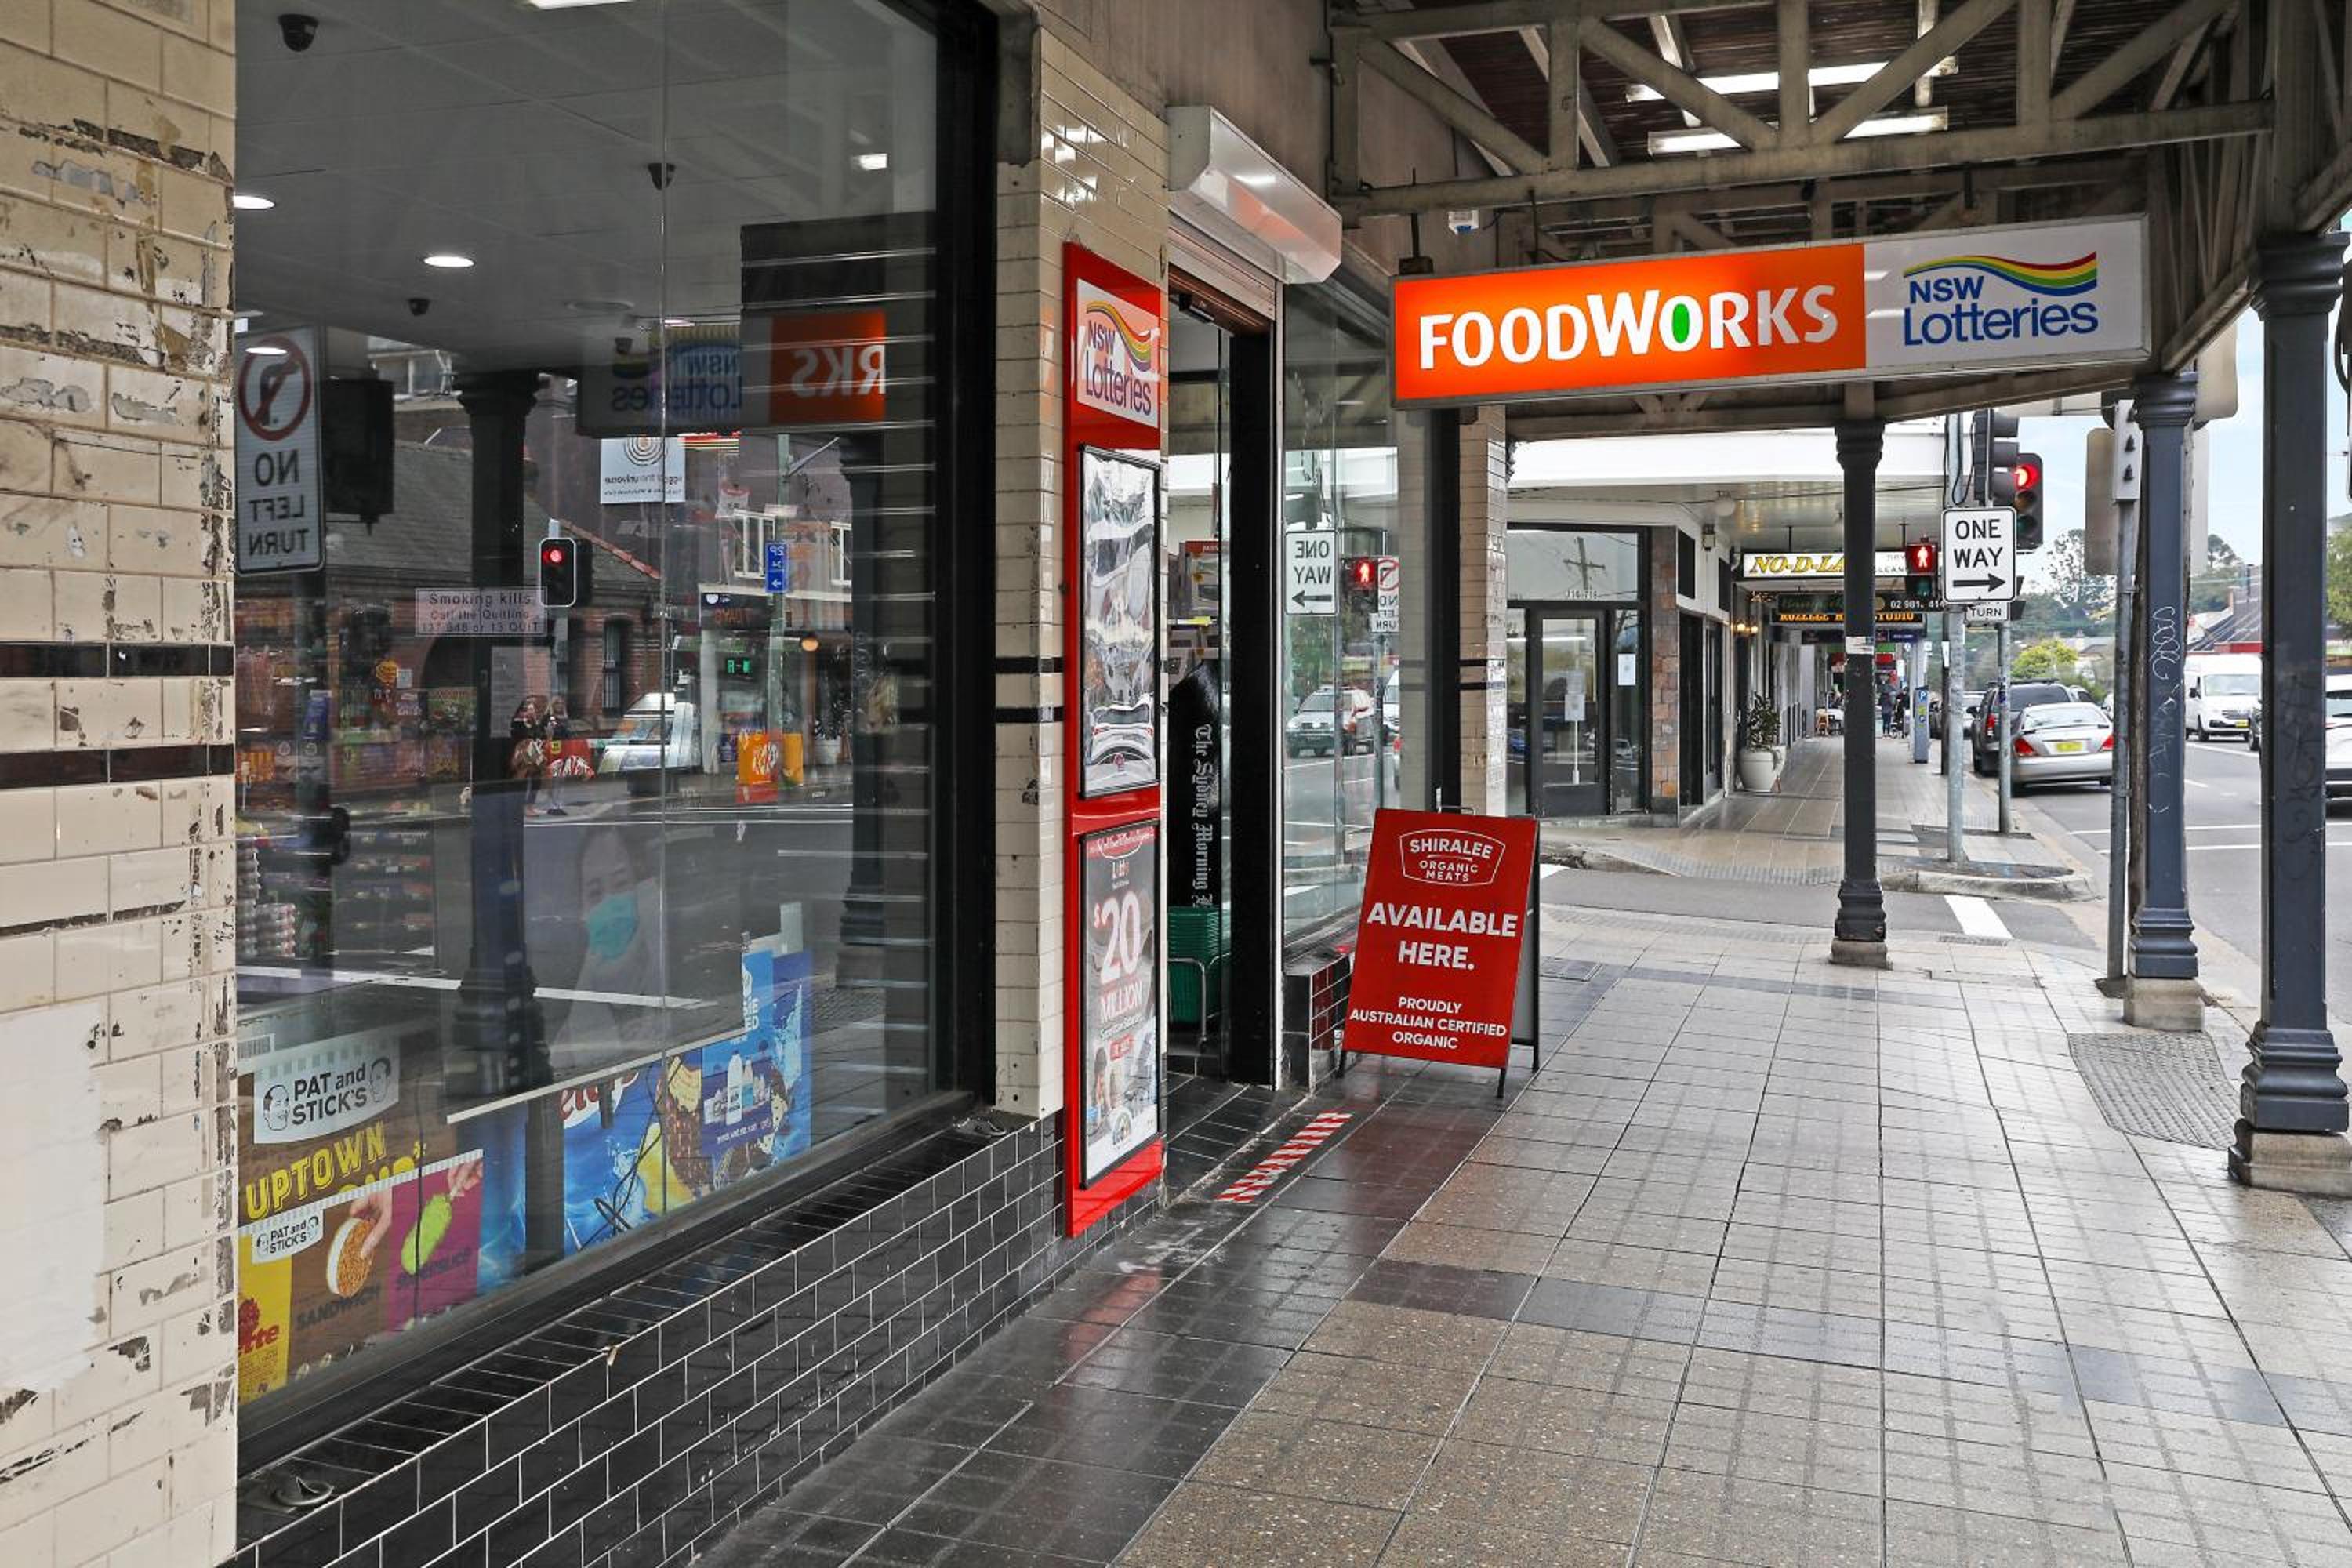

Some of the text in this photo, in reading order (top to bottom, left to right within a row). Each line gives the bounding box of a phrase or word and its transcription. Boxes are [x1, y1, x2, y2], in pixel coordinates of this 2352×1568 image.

[1909, 278, 1984, 303] NSW
[1420, 283, 1838, 371] FOODWORKS
[1903, 292, 2098, 346] Lotteries
[1088, 320, 1116, 355] NSW
[1087, 350, 1152, 416] Lotteries
[1955, 519, 2002, 540] ONE
[1953, 547, 2003, 568] WAY
[429, 593, 531, 607] Smoking kills
[1970, 608, 2002, 617] TURN
[1875, 612, 1914, 622] TUDIO
[1193, 724, 1213, 756] The
[1192, 759, 1213, 818] Sydney
[1192, 823, 1213, 890] Morning
[1409, 838, 1494, 859] SHIRALEE
[1419, 859, 1479, 873] ORGANIC
[1425, 869, 1470, 882] MEATS
[1367, 902, 1519, 937] AVAILABLE
[1398, 940, 1475, 971] HERE.
[1100, 981, 1143, 1022] MILLION
[1398, 996, 1463, 1014] PROUDLY
[1349, 1009, 1506, 1037] AUSTRALIAN CERTIFIED
[1392, 1031, 1459, 1050] ORGANIC
[294, 1063, 366, 1101] PAT and
[292, 1086, 368, 1126] STICK'S
[245, 1120, 387, 1221] UPTOWN
[269, 1230, 307, 1254] STICK'S
[270, 1216, 307, 1241] PAT and
